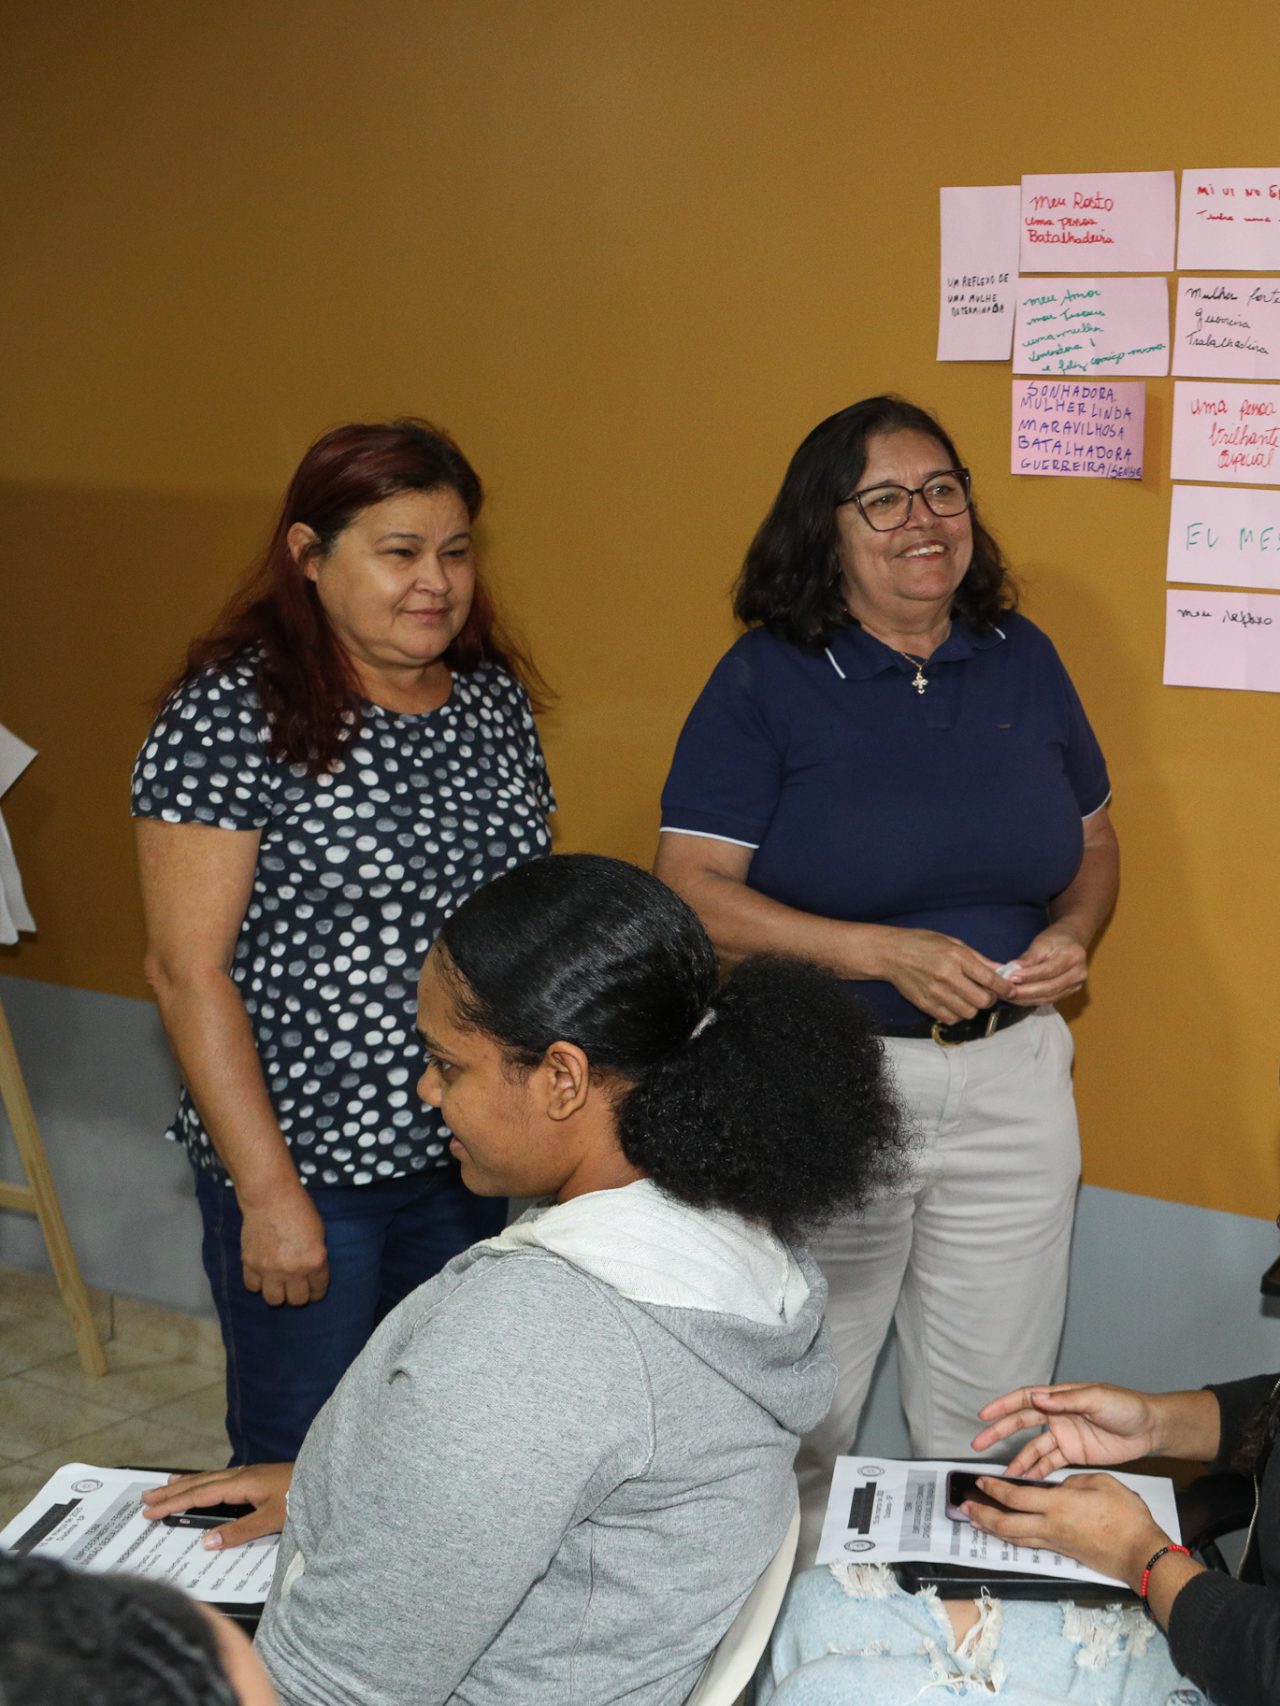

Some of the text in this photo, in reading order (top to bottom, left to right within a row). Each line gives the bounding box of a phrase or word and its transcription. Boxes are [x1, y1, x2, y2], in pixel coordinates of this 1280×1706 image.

[1020, 396, 1132, 421] MULHER LINDA
[1018, 419, 1124, 439] MARAVILHOSA
[1018, 435, 1133, 461] BATALHADORA
[1186, 522, 1219, 551] EU
